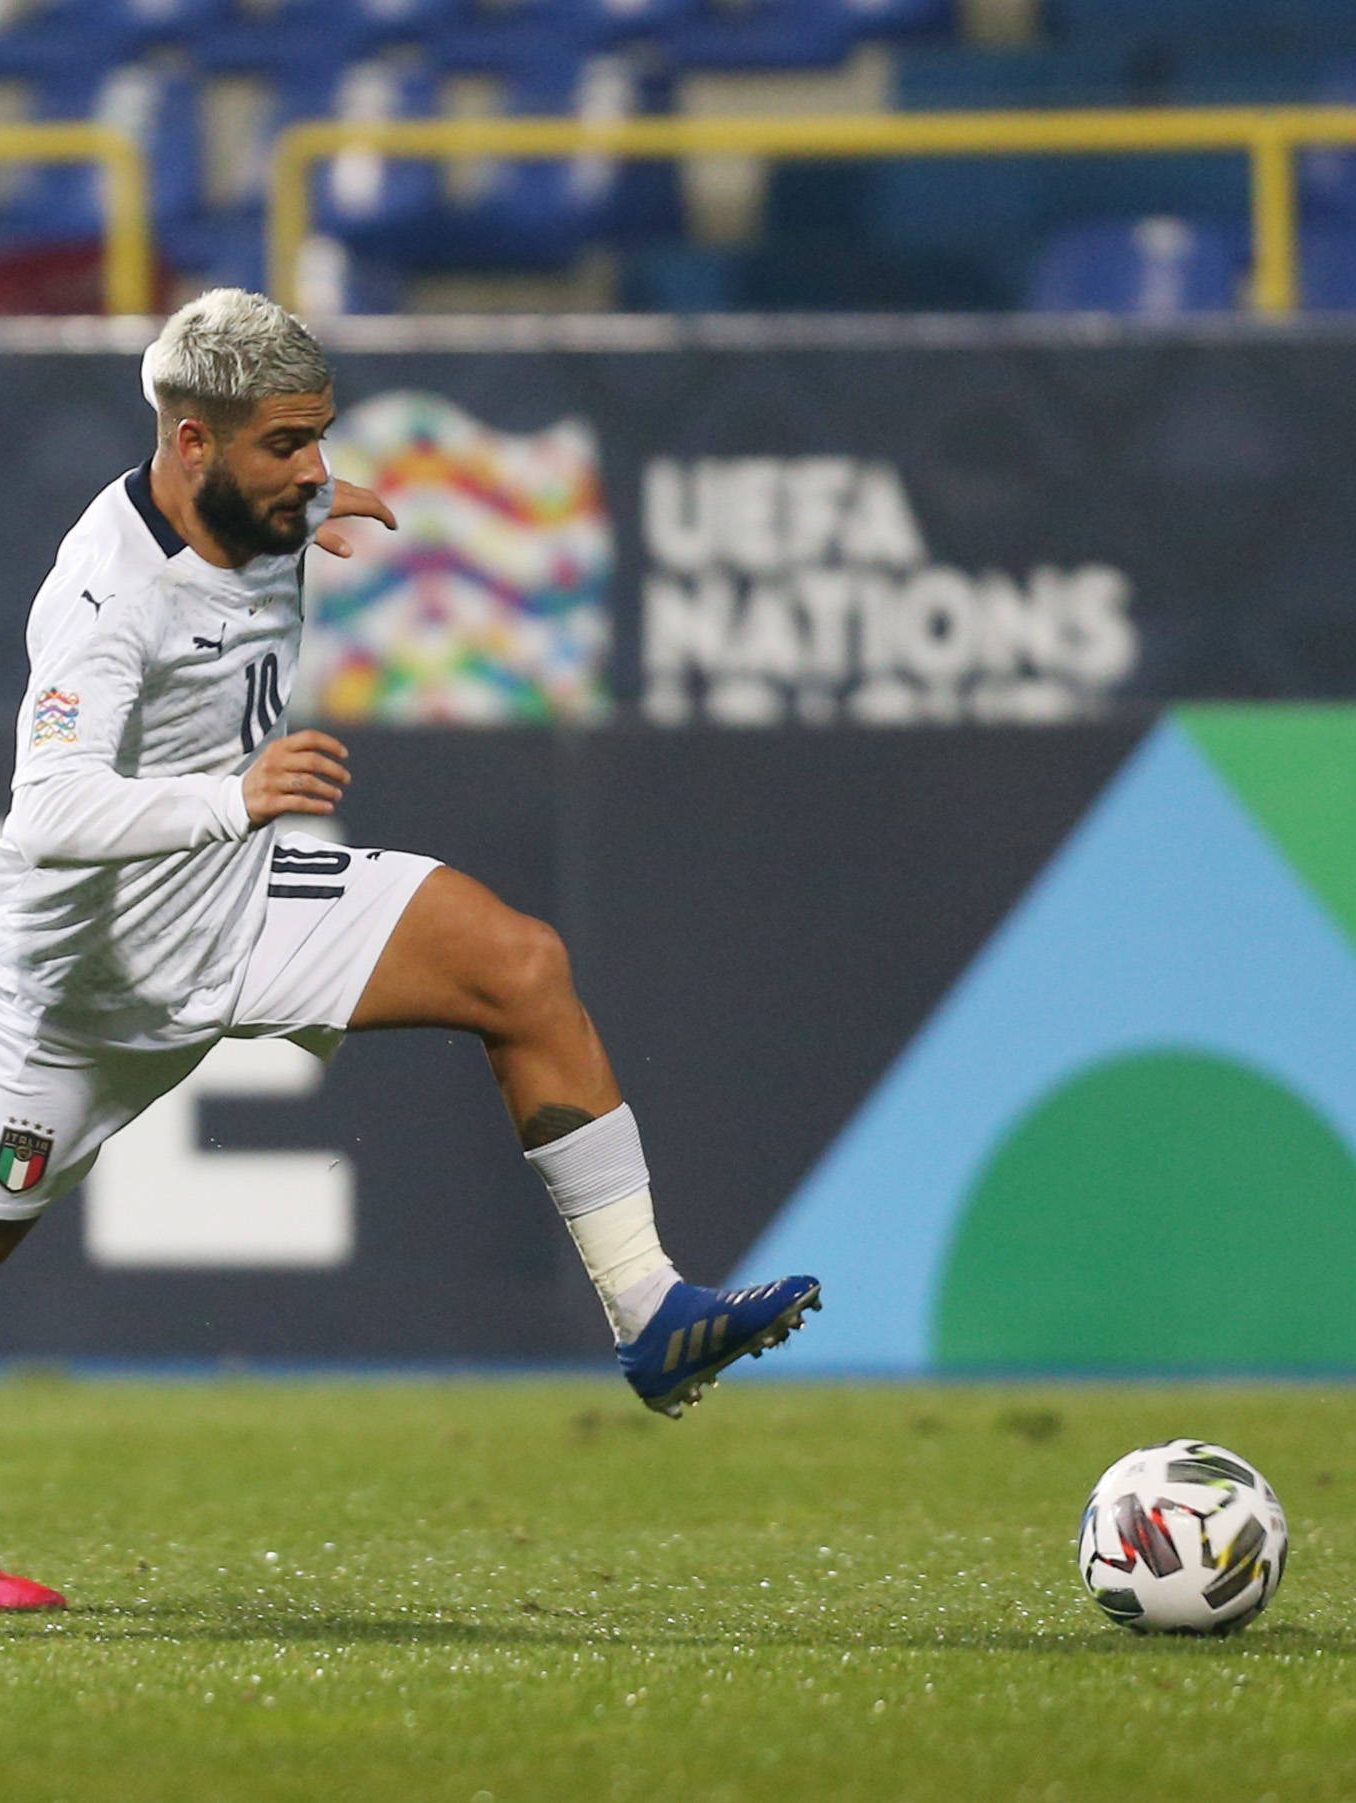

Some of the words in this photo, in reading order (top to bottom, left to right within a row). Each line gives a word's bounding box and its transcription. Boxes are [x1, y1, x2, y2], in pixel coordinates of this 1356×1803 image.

[643, 456, 928, 568] UEFA
[643, 564, 1137, 688] NATIONS
[241, 653, 284, 754] 10
[267, 844, 351, 900] 10
